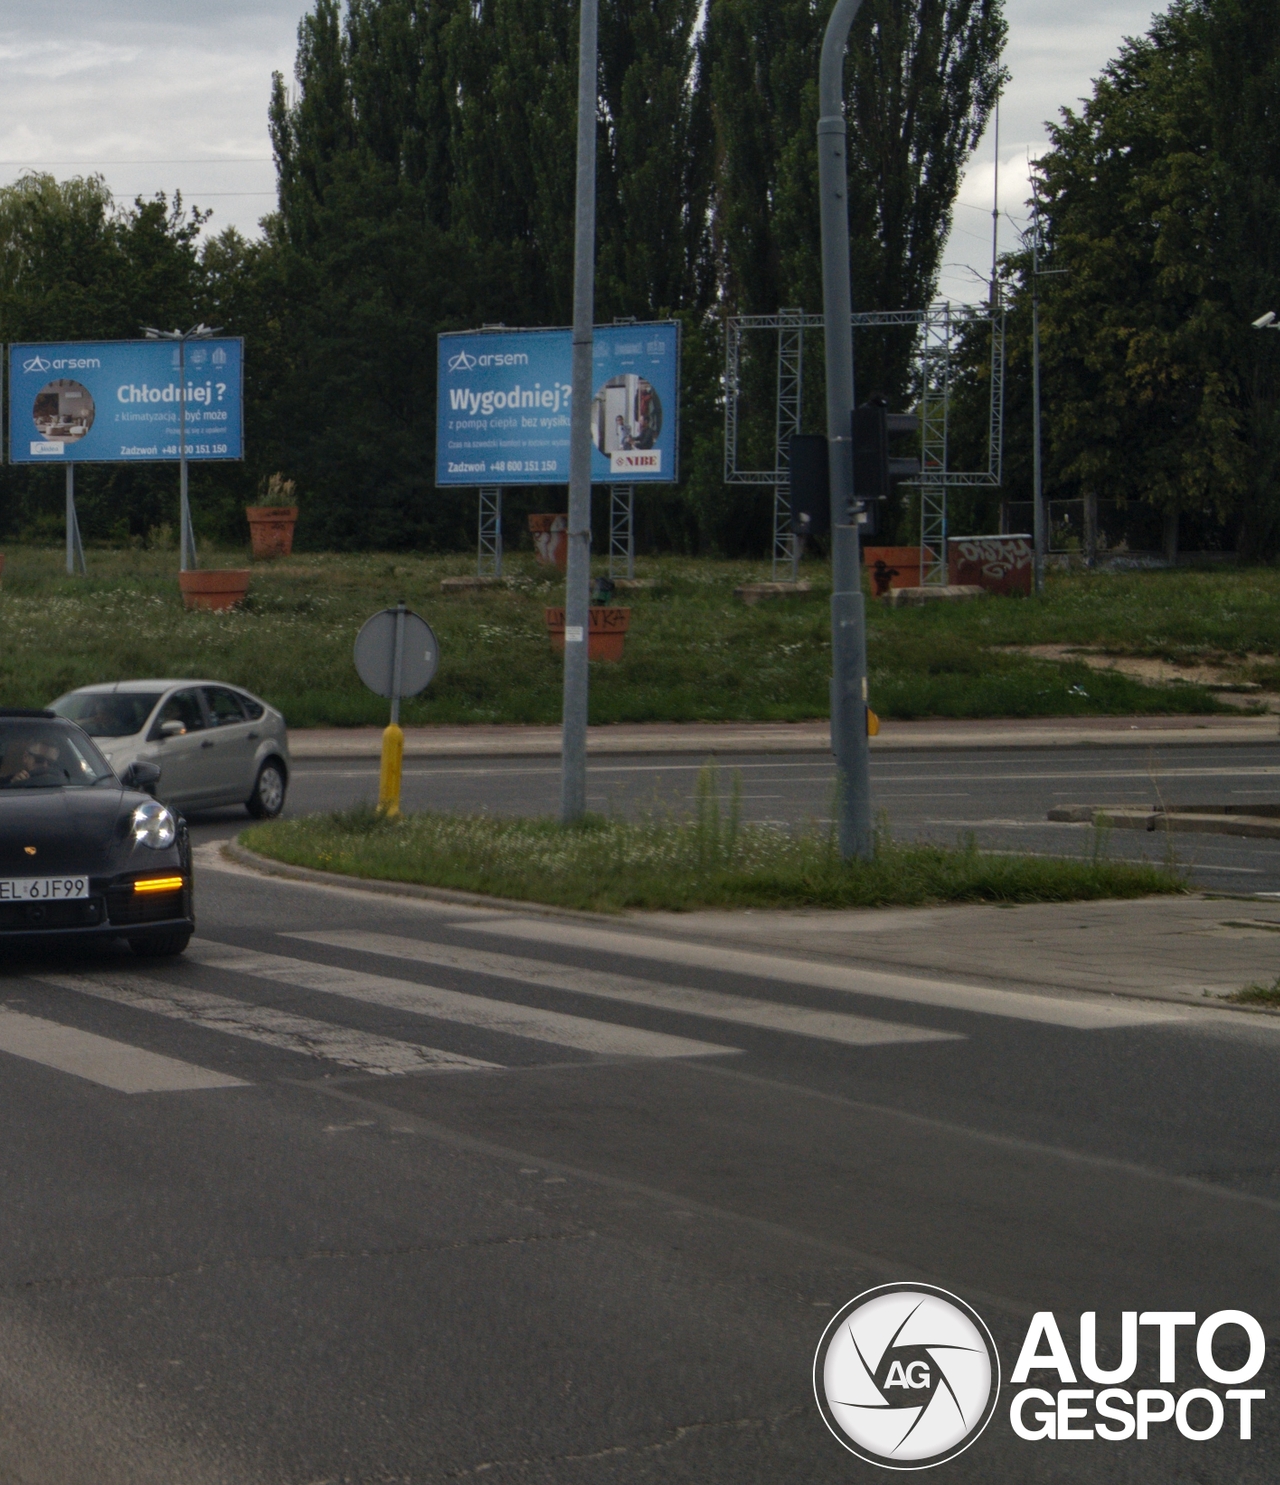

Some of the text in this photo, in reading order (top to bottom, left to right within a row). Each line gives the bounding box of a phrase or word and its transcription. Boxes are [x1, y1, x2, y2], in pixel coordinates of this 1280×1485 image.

[53, 357, 101, 369] arsem
[478, 352, 529, 367] arsem
[449, 382, 572, 416] Wygodniej?
[185, 409, 201, 423] być
[203, 409, 227, 420] może
[448, 421, 453, 429] z
[456, 419, 487, 431] pompą
[489, 417, 517, 430] ciepła
[521, 416, 537, 428] bez
[120, 445, 157, 456] Zadzwoń
[161, 445, 177, 454] +48
[195, 444, 210, 454] 151
[212, 444, 227, 453] 150
[448, 460, 557, 473] Zadzwoń +48 600 151 150
[625, 456, 658, 467] NIBE
[0, 879, 85, 899] EL 6JF99
